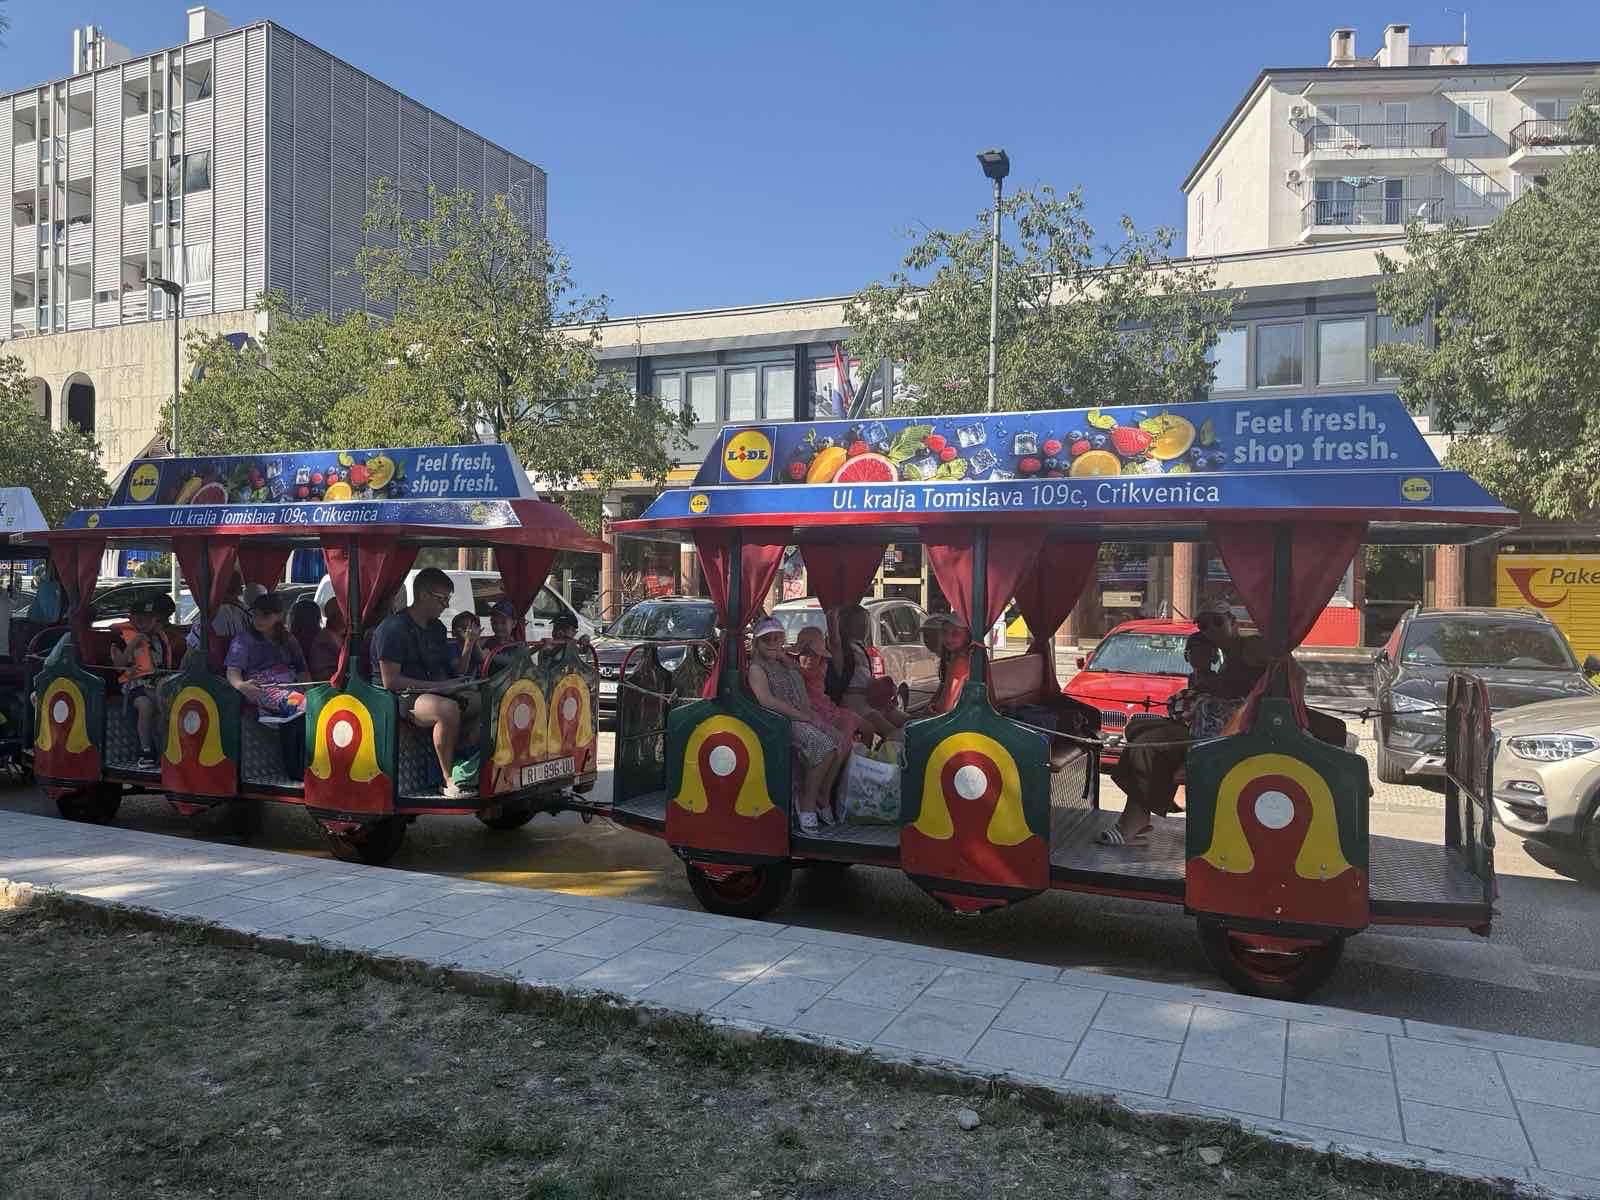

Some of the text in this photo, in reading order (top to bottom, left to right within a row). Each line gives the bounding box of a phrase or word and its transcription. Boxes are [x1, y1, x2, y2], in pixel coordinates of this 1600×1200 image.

[1235, 405, 1386, 435] Feel fresh,
[416, 451, 496, 473] Feel fresh,
[1233, 434, 1399, 469] shop fresh.
[411, 473, 498, 497] shop fresh.
[832, 482, 1220, 512] Ul. kralja Tomislava 109c, Crikvenica
[169, 505, 378, 527] Ul. kralja Tomislava 109c, Crikvenica
